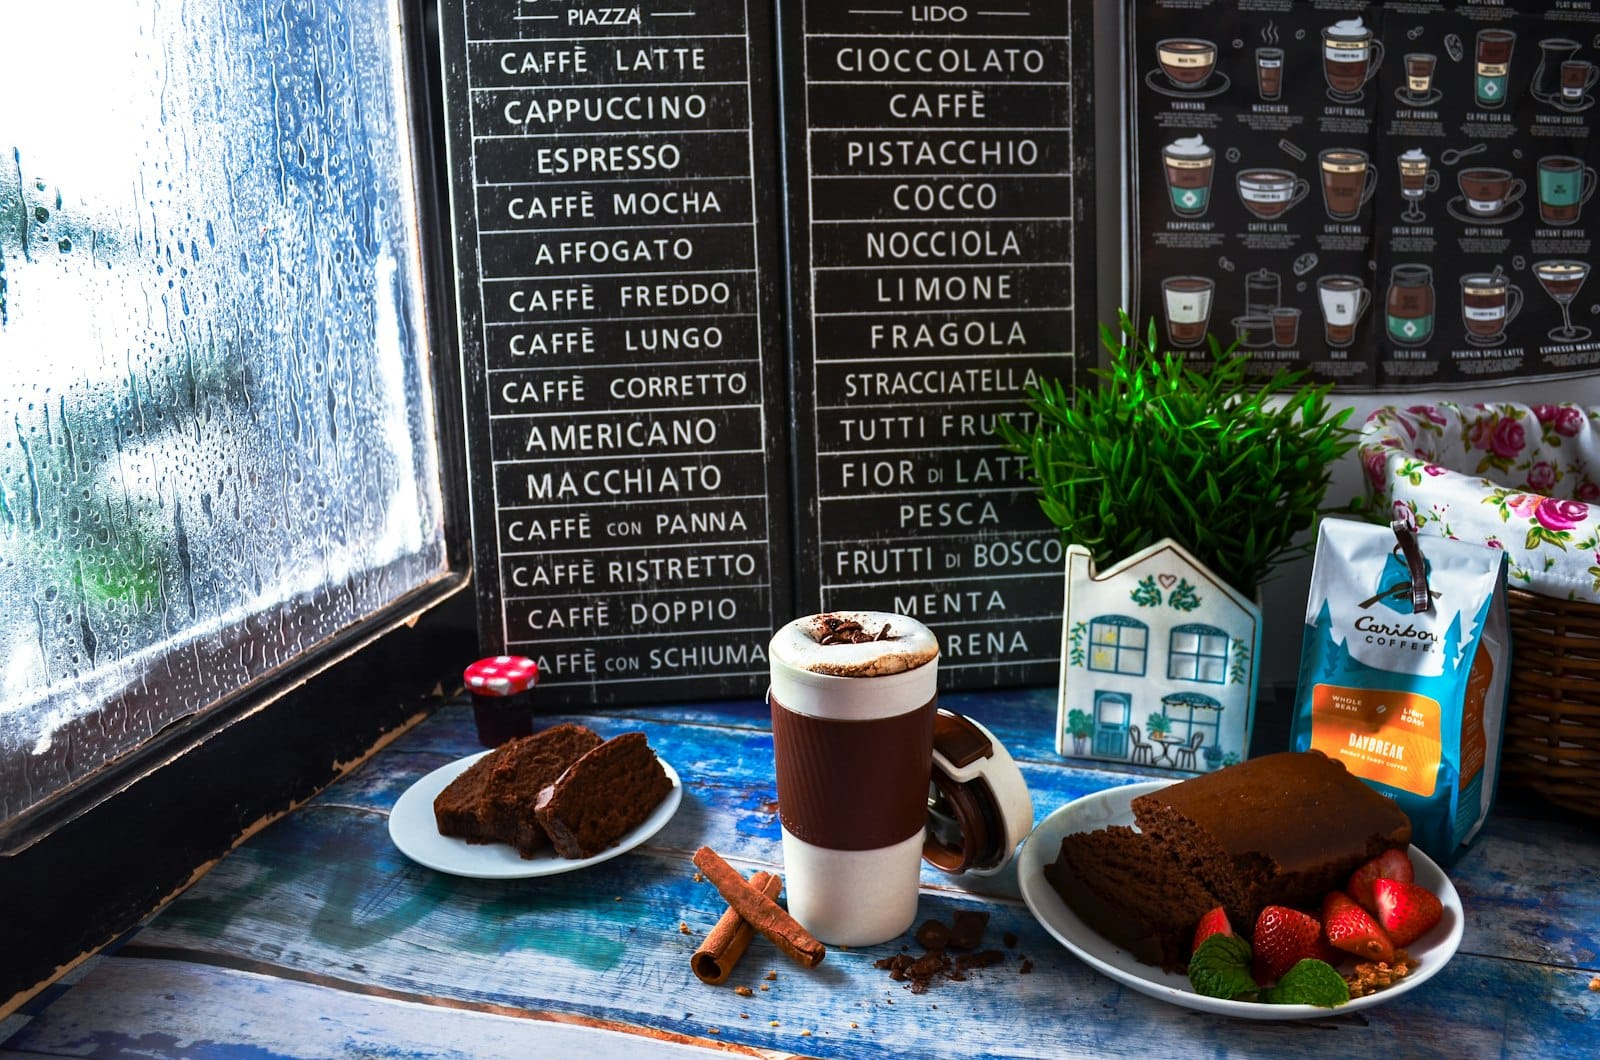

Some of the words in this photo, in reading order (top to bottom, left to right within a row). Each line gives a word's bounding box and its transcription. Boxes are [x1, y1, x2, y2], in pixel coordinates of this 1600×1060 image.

[567, 8, 641, 25] PIAZZA
[911, 6, 968, 22] LIDO
[500, 46, 588, 75] CAFFÈ
[616, 48, 706, 72] LATTE
[836, 48, 1045, 74] CIOCCOLATO
[503, 94, 707, 125] CAPPUCCINO
[889, 90, 986, 118] CAFFÈ
[537, 144, 681, 174] ESPRESSO
[847, 140, 1038, 166] PISTACCHIO
[508, 191, 595, 220] CAFFÈ
[614, 191, 721, 216] MOCHA
[893, 184, 997, 211] COCCO
[535, 238, 693, 265] AFFOGATO
[867, 230, 1021, 259] NOCCIOLA
[509, 284, 595, 312] CAFFÈ
[620, 282, 730, 308] FREDDO
[877, 275, 1012, 302] LIMONE
[509, 327, 595, 356] CAFFÈ
[626, 326, 723, 351] LUNGO
[871, 321, 1027, 349] FRAGOLA
[502, 375, 585, 404] CAFFÈ
[609, 373, 747, 400] CORRETTO
[845, 368, 1039, 398] STRACCIATELLA
[526, 417, 717, 452] AMERICANO
[840, 416, 925, 442] TUTTI
[527, 464, 722, 499] MACCHIATO
[841, 460, 915, 488] FIOR
[928, 468, 944, 484] DI
[956, 456, 1040, 483] LATT
[508, 513, 592, 541] CAFFÈ
[607, 522, 642, 537] CON
[656, 511, 748, 535] PANNA
[900, 501, 1000, 528] PESCA
[513, 559, 595, 587] CAFFÈ
[609, 554, 756, 584] RISTRETTO
[836, 546, 932, 575] FRUTTI
[945, 553, 961, 568] DI
[974, 538, 1063, 568] BOSCO
[528, 602, 609, 629] CAFFÈ
[631, 598, 737, 625] DOPPIO
[894, 590, 1006, 615] MENTA
[1354, 616, 1438, 643] Caribou
[1365, 634, 1431, 653] COFFEE
[537, 648, 597, 674] AFFÈ
[605, 656, 640, 671] CON
[650, 644, 767, 669] SCHIUMA
[1332, 695, 1363, 706] WHOLE
[1334, 703, 1358, 712] BEAN
[1348, 732, 1405, 761] DAYBREAK
